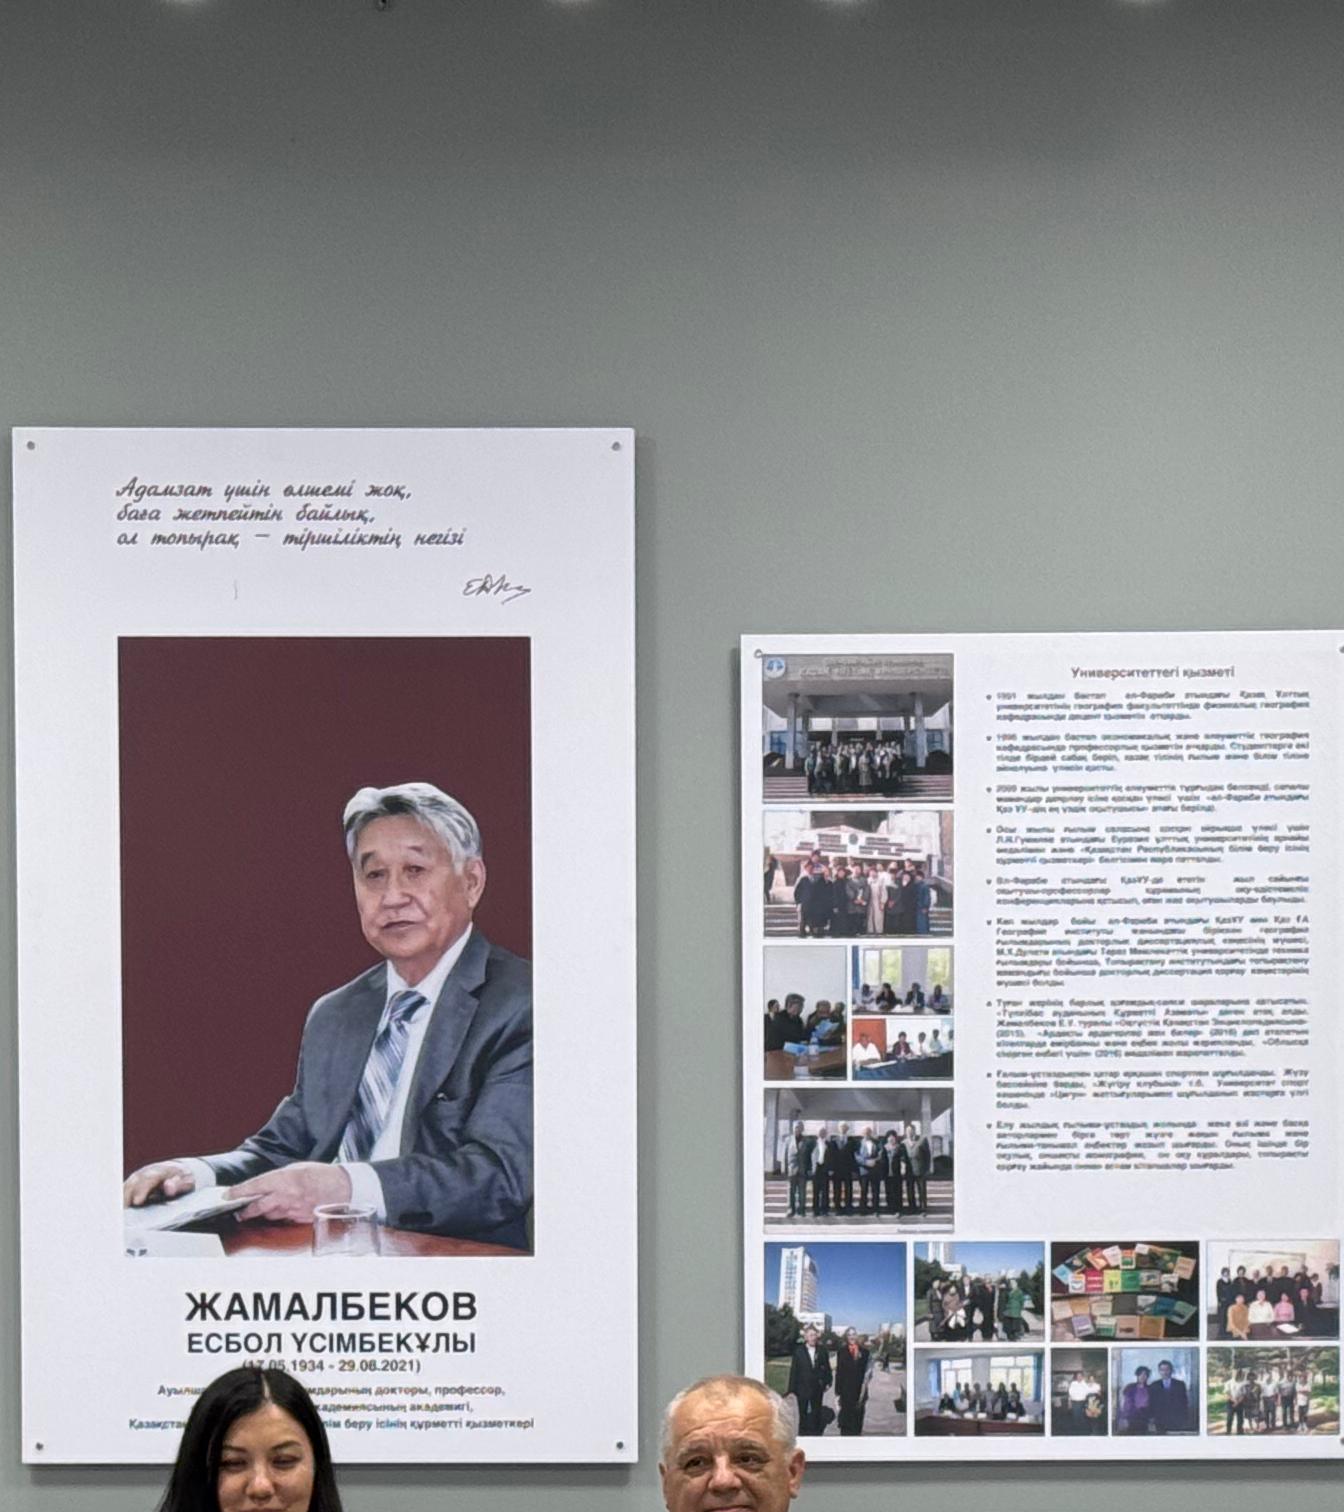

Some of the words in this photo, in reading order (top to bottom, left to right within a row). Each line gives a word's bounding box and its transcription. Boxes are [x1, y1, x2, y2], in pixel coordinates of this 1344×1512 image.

[185, 1291, 477, 1322] ЖАМАЛБЕКОВ
[187, 1332, 282, 1353] ЕСБОЛ
[291, 1331, 476, 1353] ҮСІМБЕКҰЛЫ
